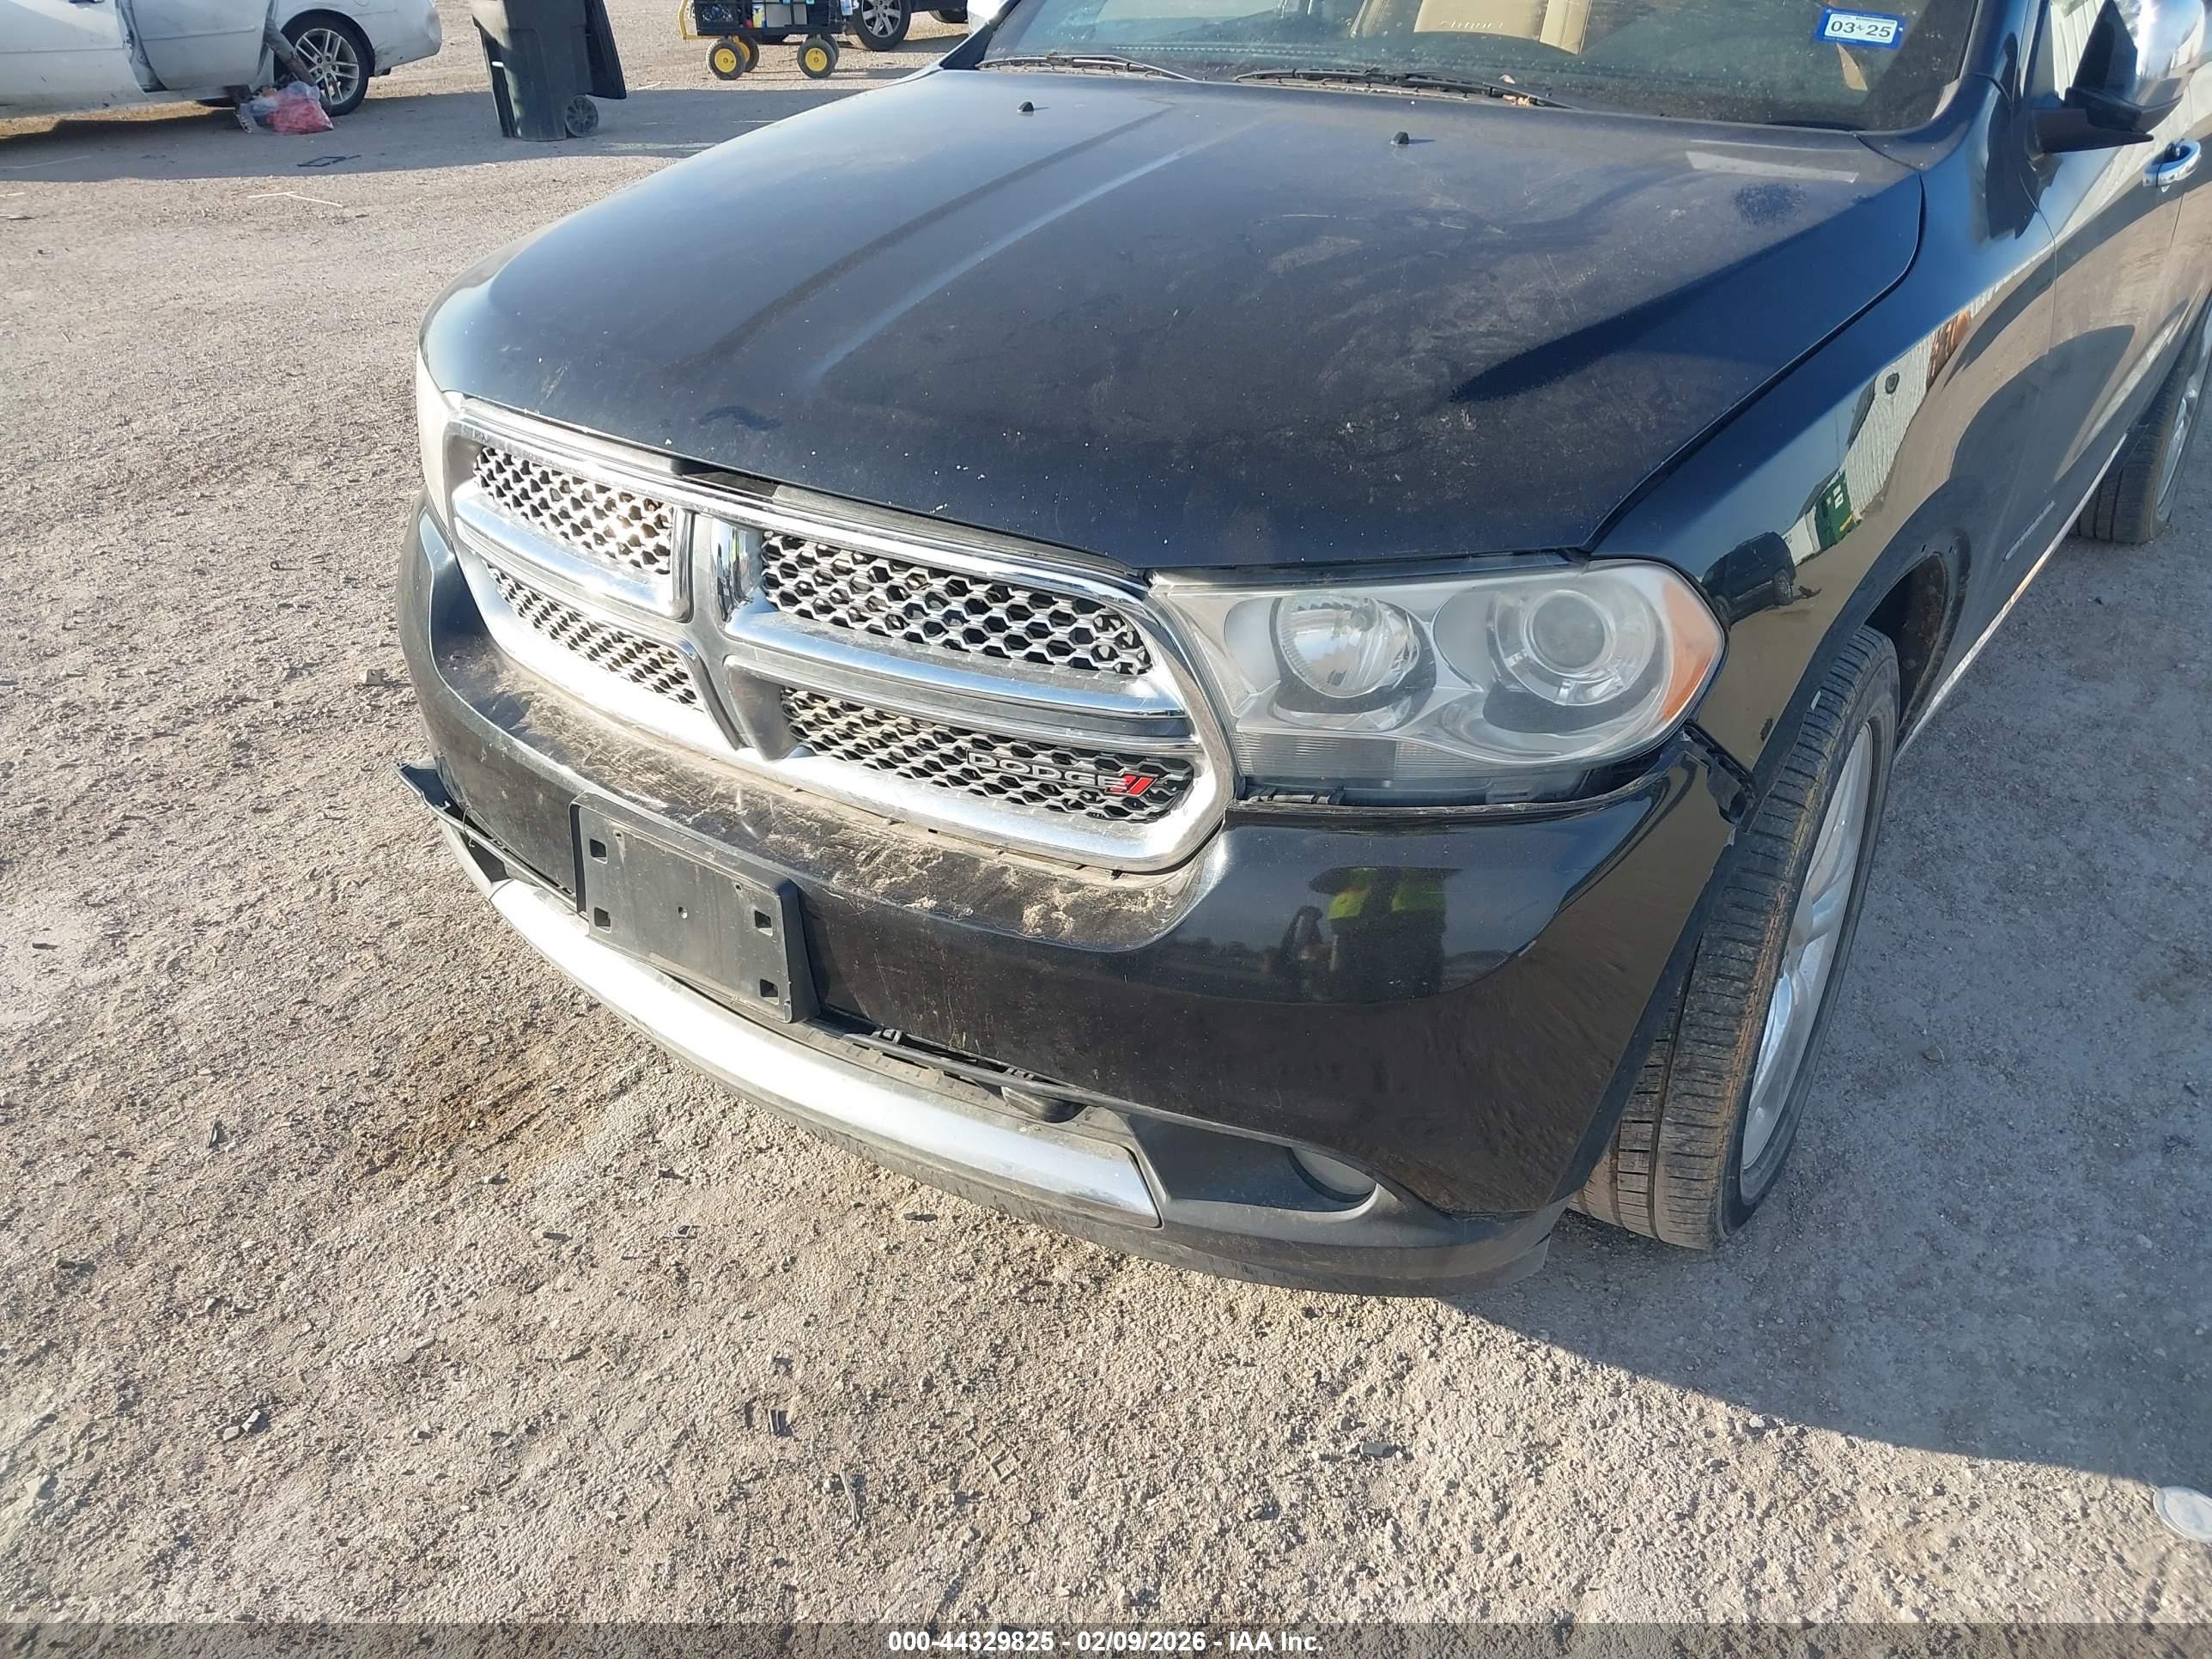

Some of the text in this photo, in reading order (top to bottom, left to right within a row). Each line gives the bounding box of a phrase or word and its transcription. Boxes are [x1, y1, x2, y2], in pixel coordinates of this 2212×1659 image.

[1831, 21, 1892, 38] 03 25
[969, 752, 1127, 789] DODGE
